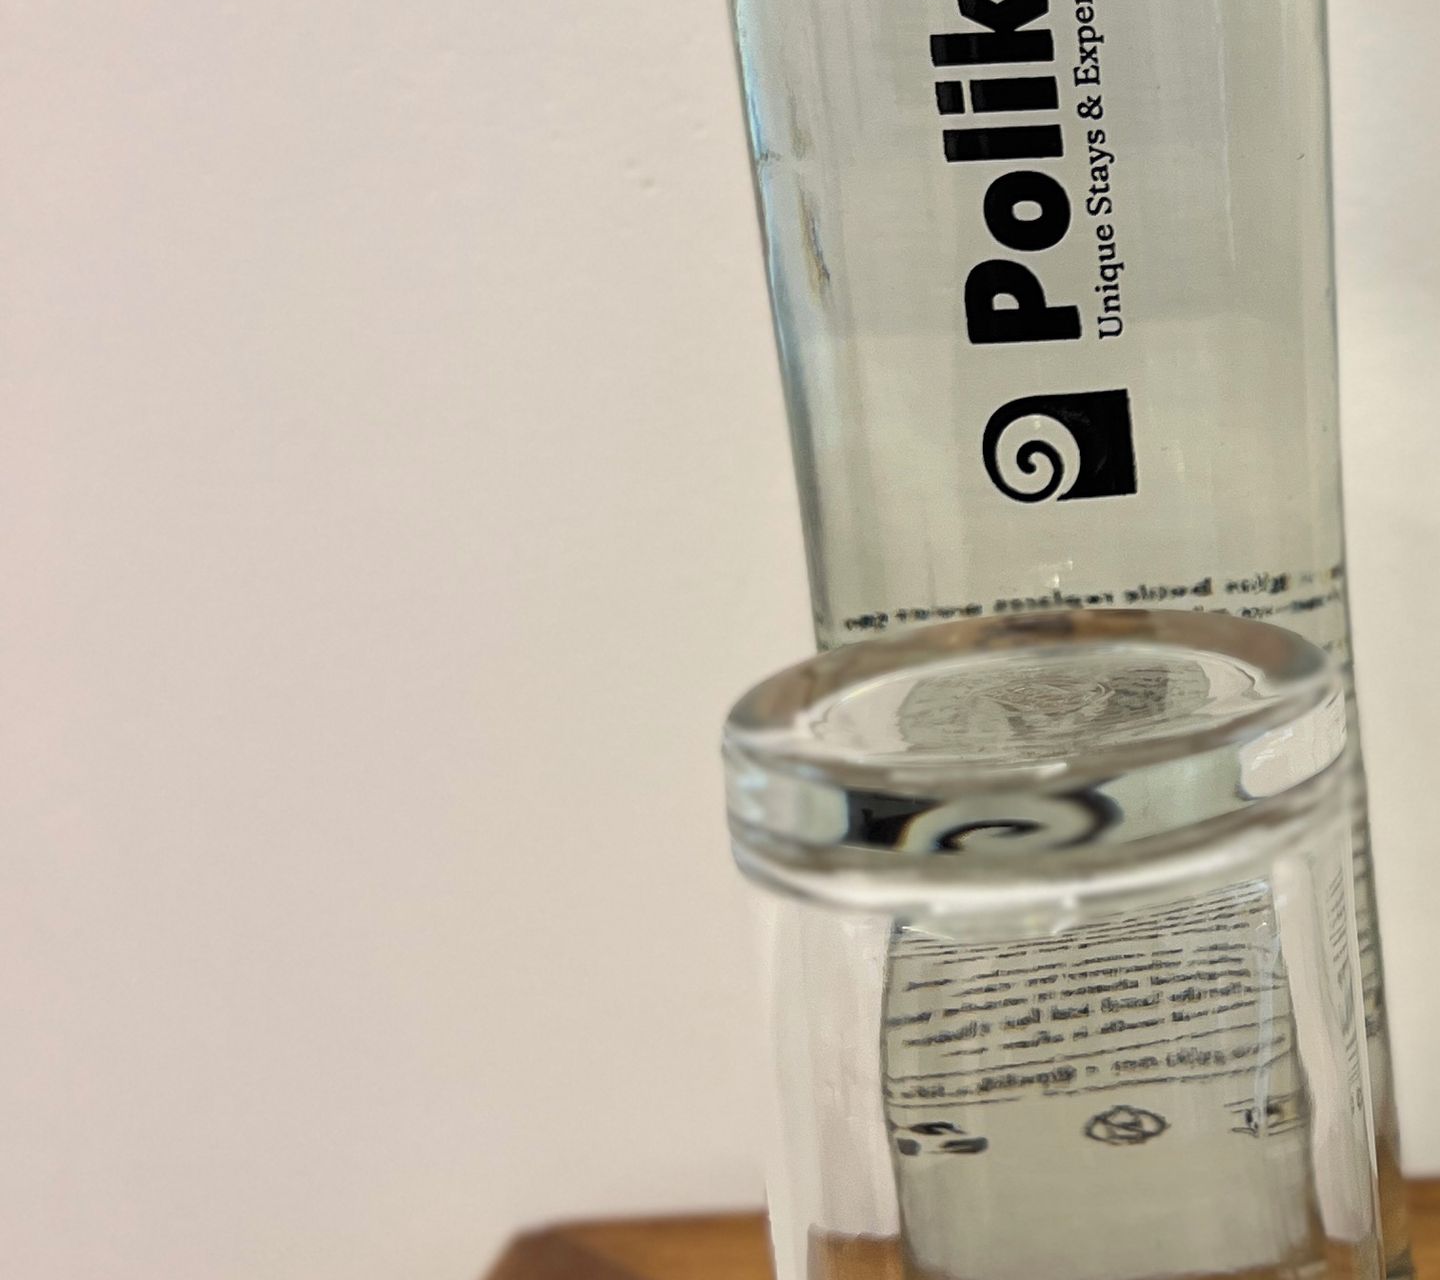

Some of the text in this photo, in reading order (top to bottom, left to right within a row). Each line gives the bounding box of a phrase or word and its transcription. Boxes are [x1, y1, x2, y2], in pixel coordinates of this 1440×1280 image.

[1076, 95, 1104, 121] &
[1085, 129, 1115, 216] Stays
[1094, 224, 1125, 340] Unique
